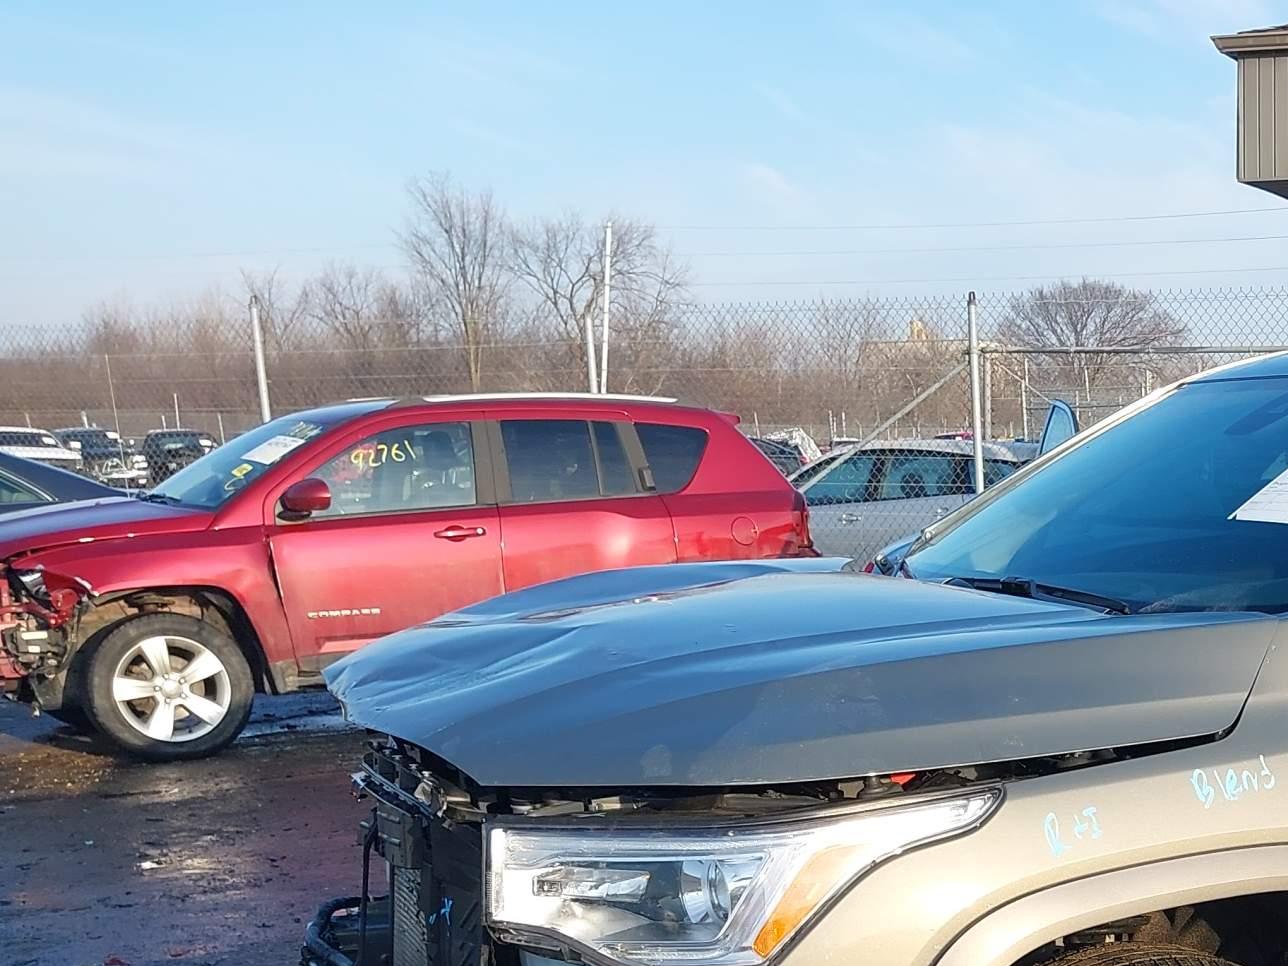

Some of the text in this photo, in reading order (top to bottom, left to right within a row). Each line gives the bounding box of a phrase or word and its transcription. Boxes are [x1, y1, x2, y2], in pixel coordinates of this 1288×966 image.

[350, 439, 417, 473] 92761
[306, 607, 382, 620] COMPASS
[1189, 753, 1277, 809] Blend
